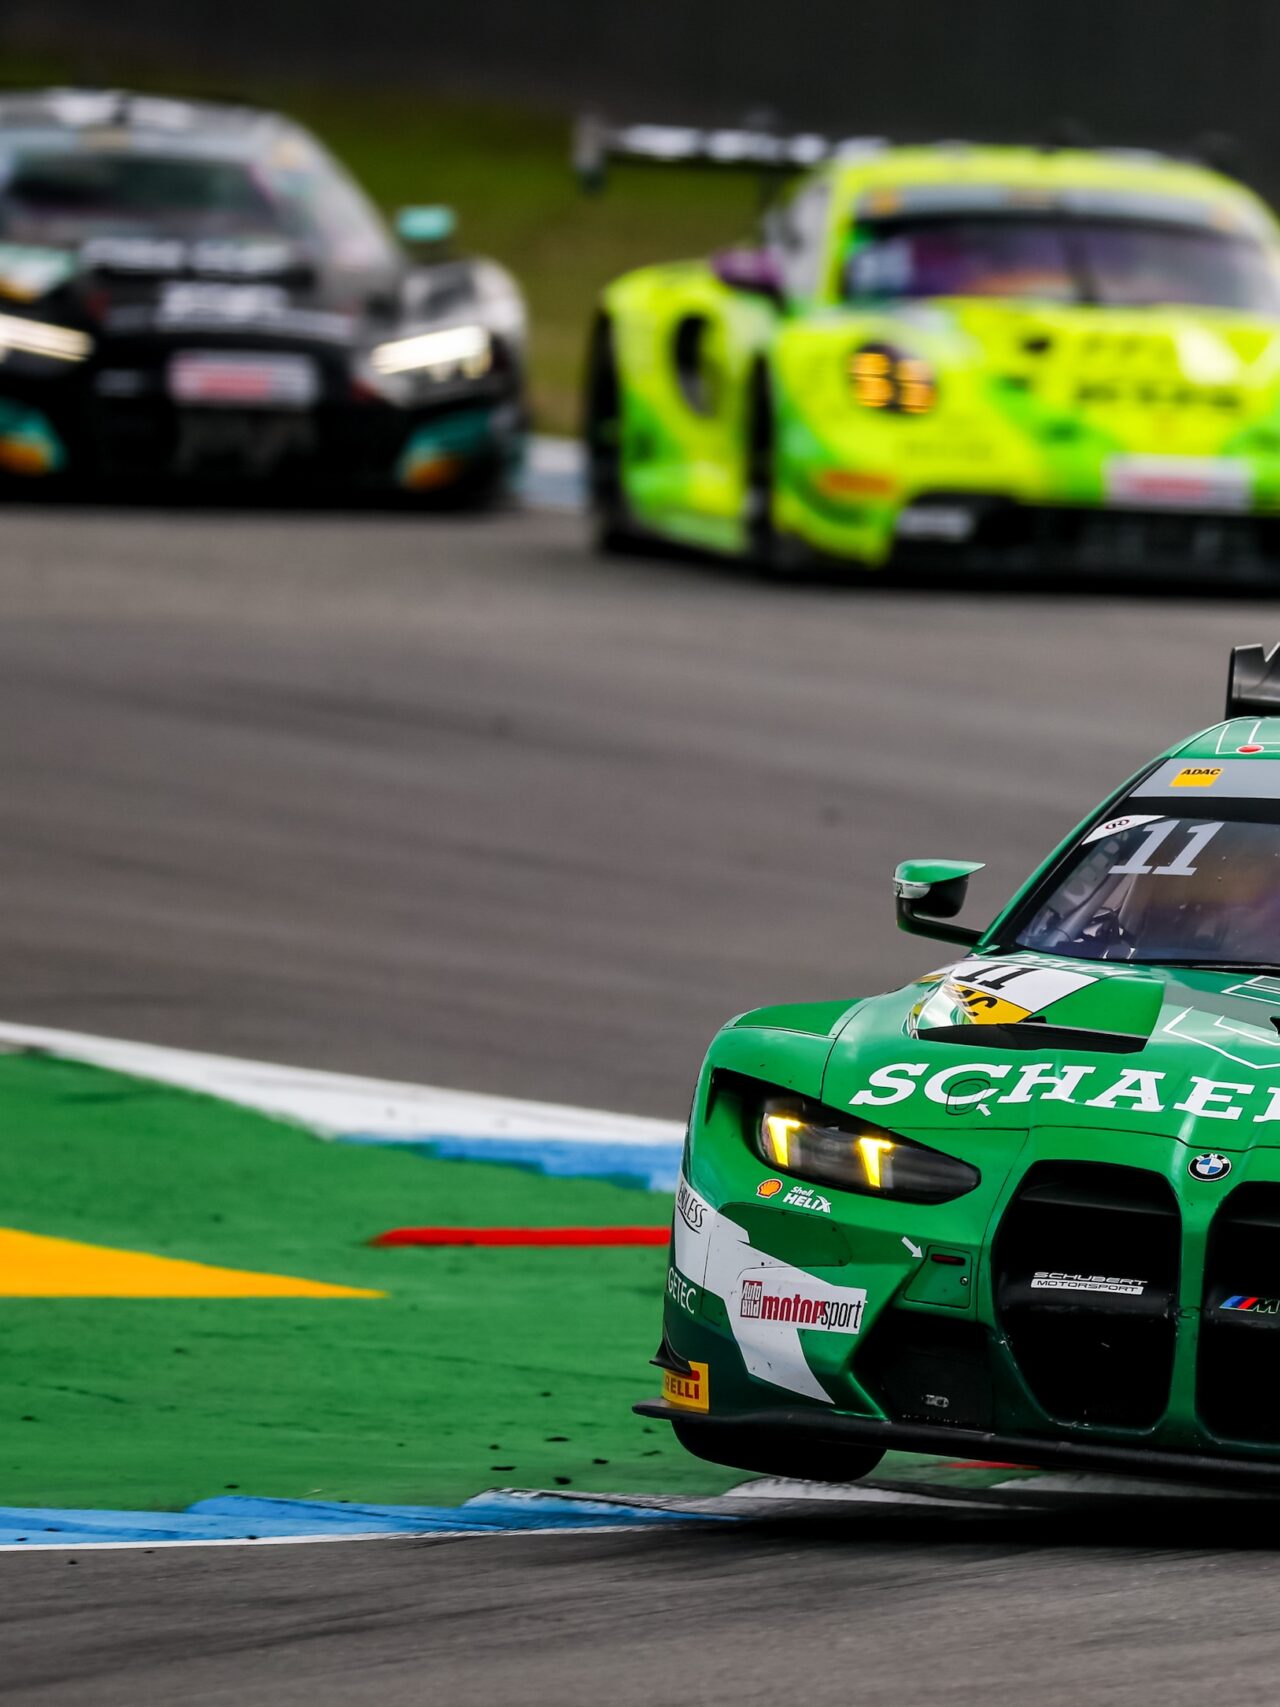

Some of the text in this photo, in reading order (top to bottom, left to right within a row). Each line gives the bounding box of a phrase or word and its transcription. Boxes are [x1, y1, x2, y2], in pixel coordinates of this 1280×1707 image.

[1180, 768, 1221, 776] ADAC
[1107, 819, 1225, 876] 11
[954, 964, 1042, 990] 11
[792, 1186, 814, 1197] Shell
[677, 1183, 707, 1228] ENDLESS
[783, 1191, 832, 1213] HELIX
[1034, 1271, 1149, 1286] SCHUBERT
[1036, 1280, 1139, 1293] MOTORSPORT
[668, 1267, 697, 1315] GETEC
[742, 1282, 761, 1300] Auto
[742, 1301, 760, 1317] Bild
